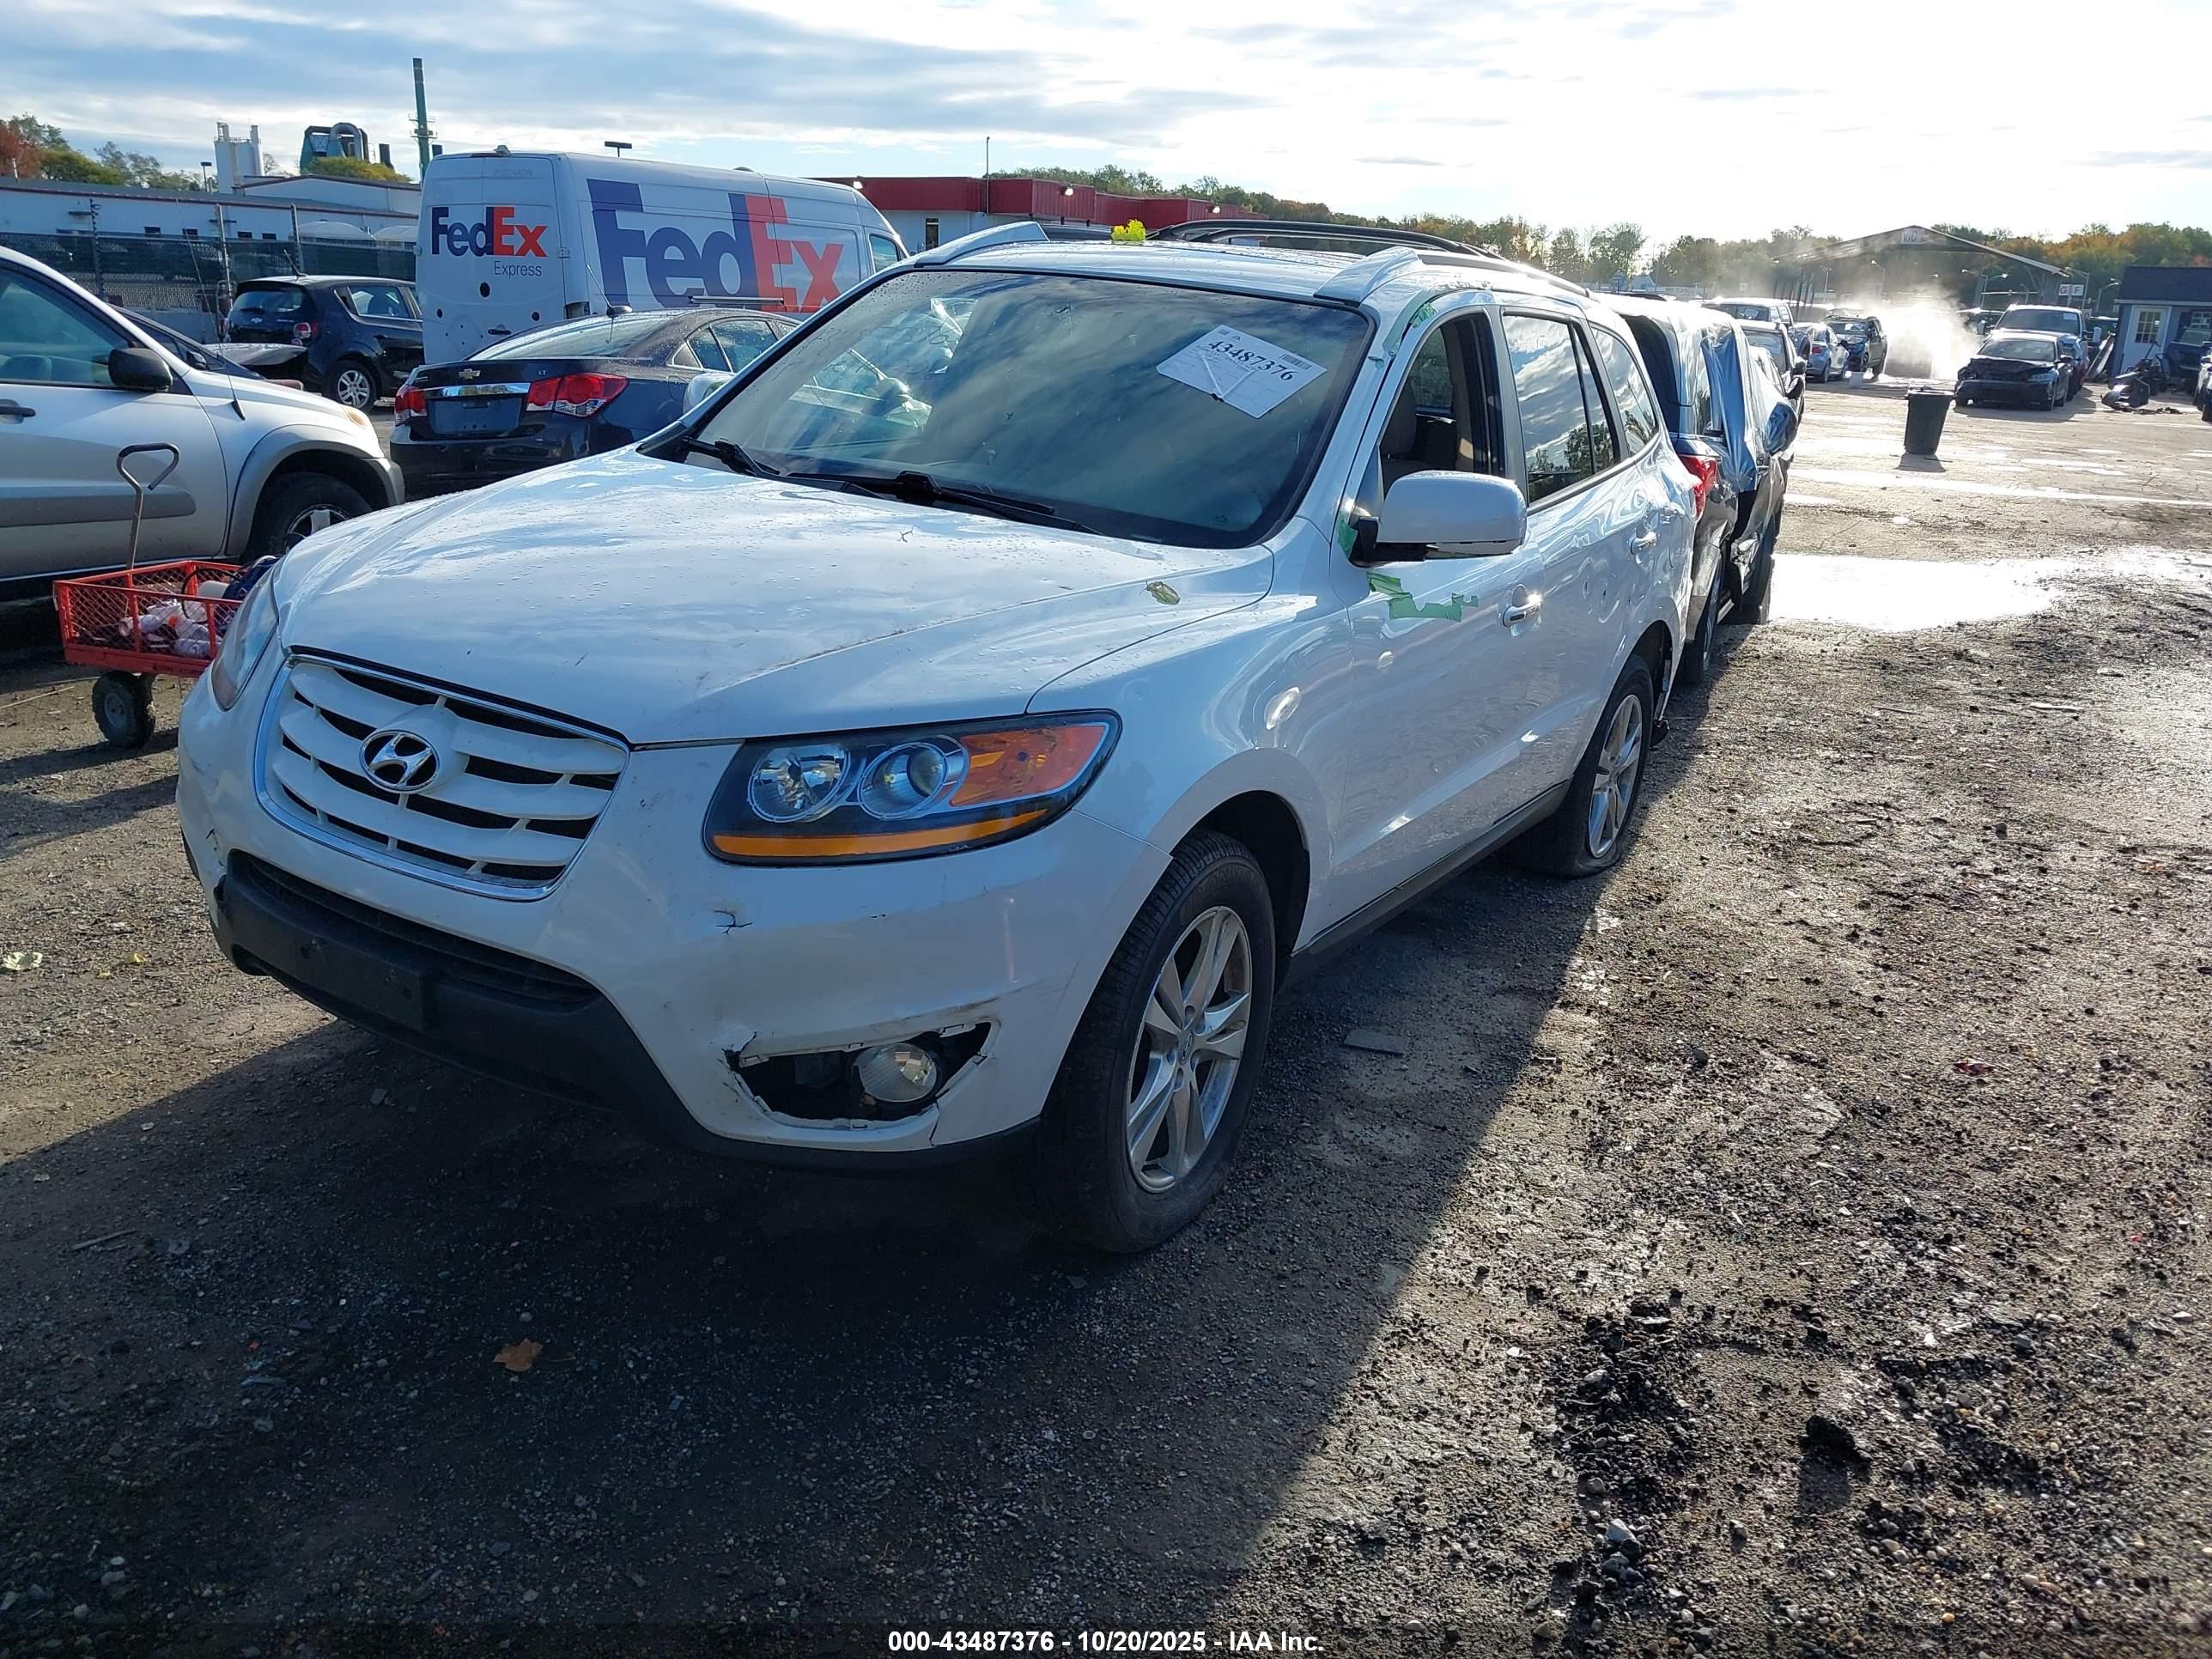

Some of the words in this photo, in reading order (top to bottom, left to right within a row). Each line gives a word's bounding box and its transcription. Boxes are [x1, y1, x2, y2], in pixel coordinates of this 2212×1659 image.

[431, 206, 548, 258] FedEx
[587, 178, 844, 312] FedEx
[494, 260, 543, 278] Express
[2060, 285, 2069, 295] G
[2074, 286, 2081, 295] F
[1208, 340, 1299, 381] 43487376
